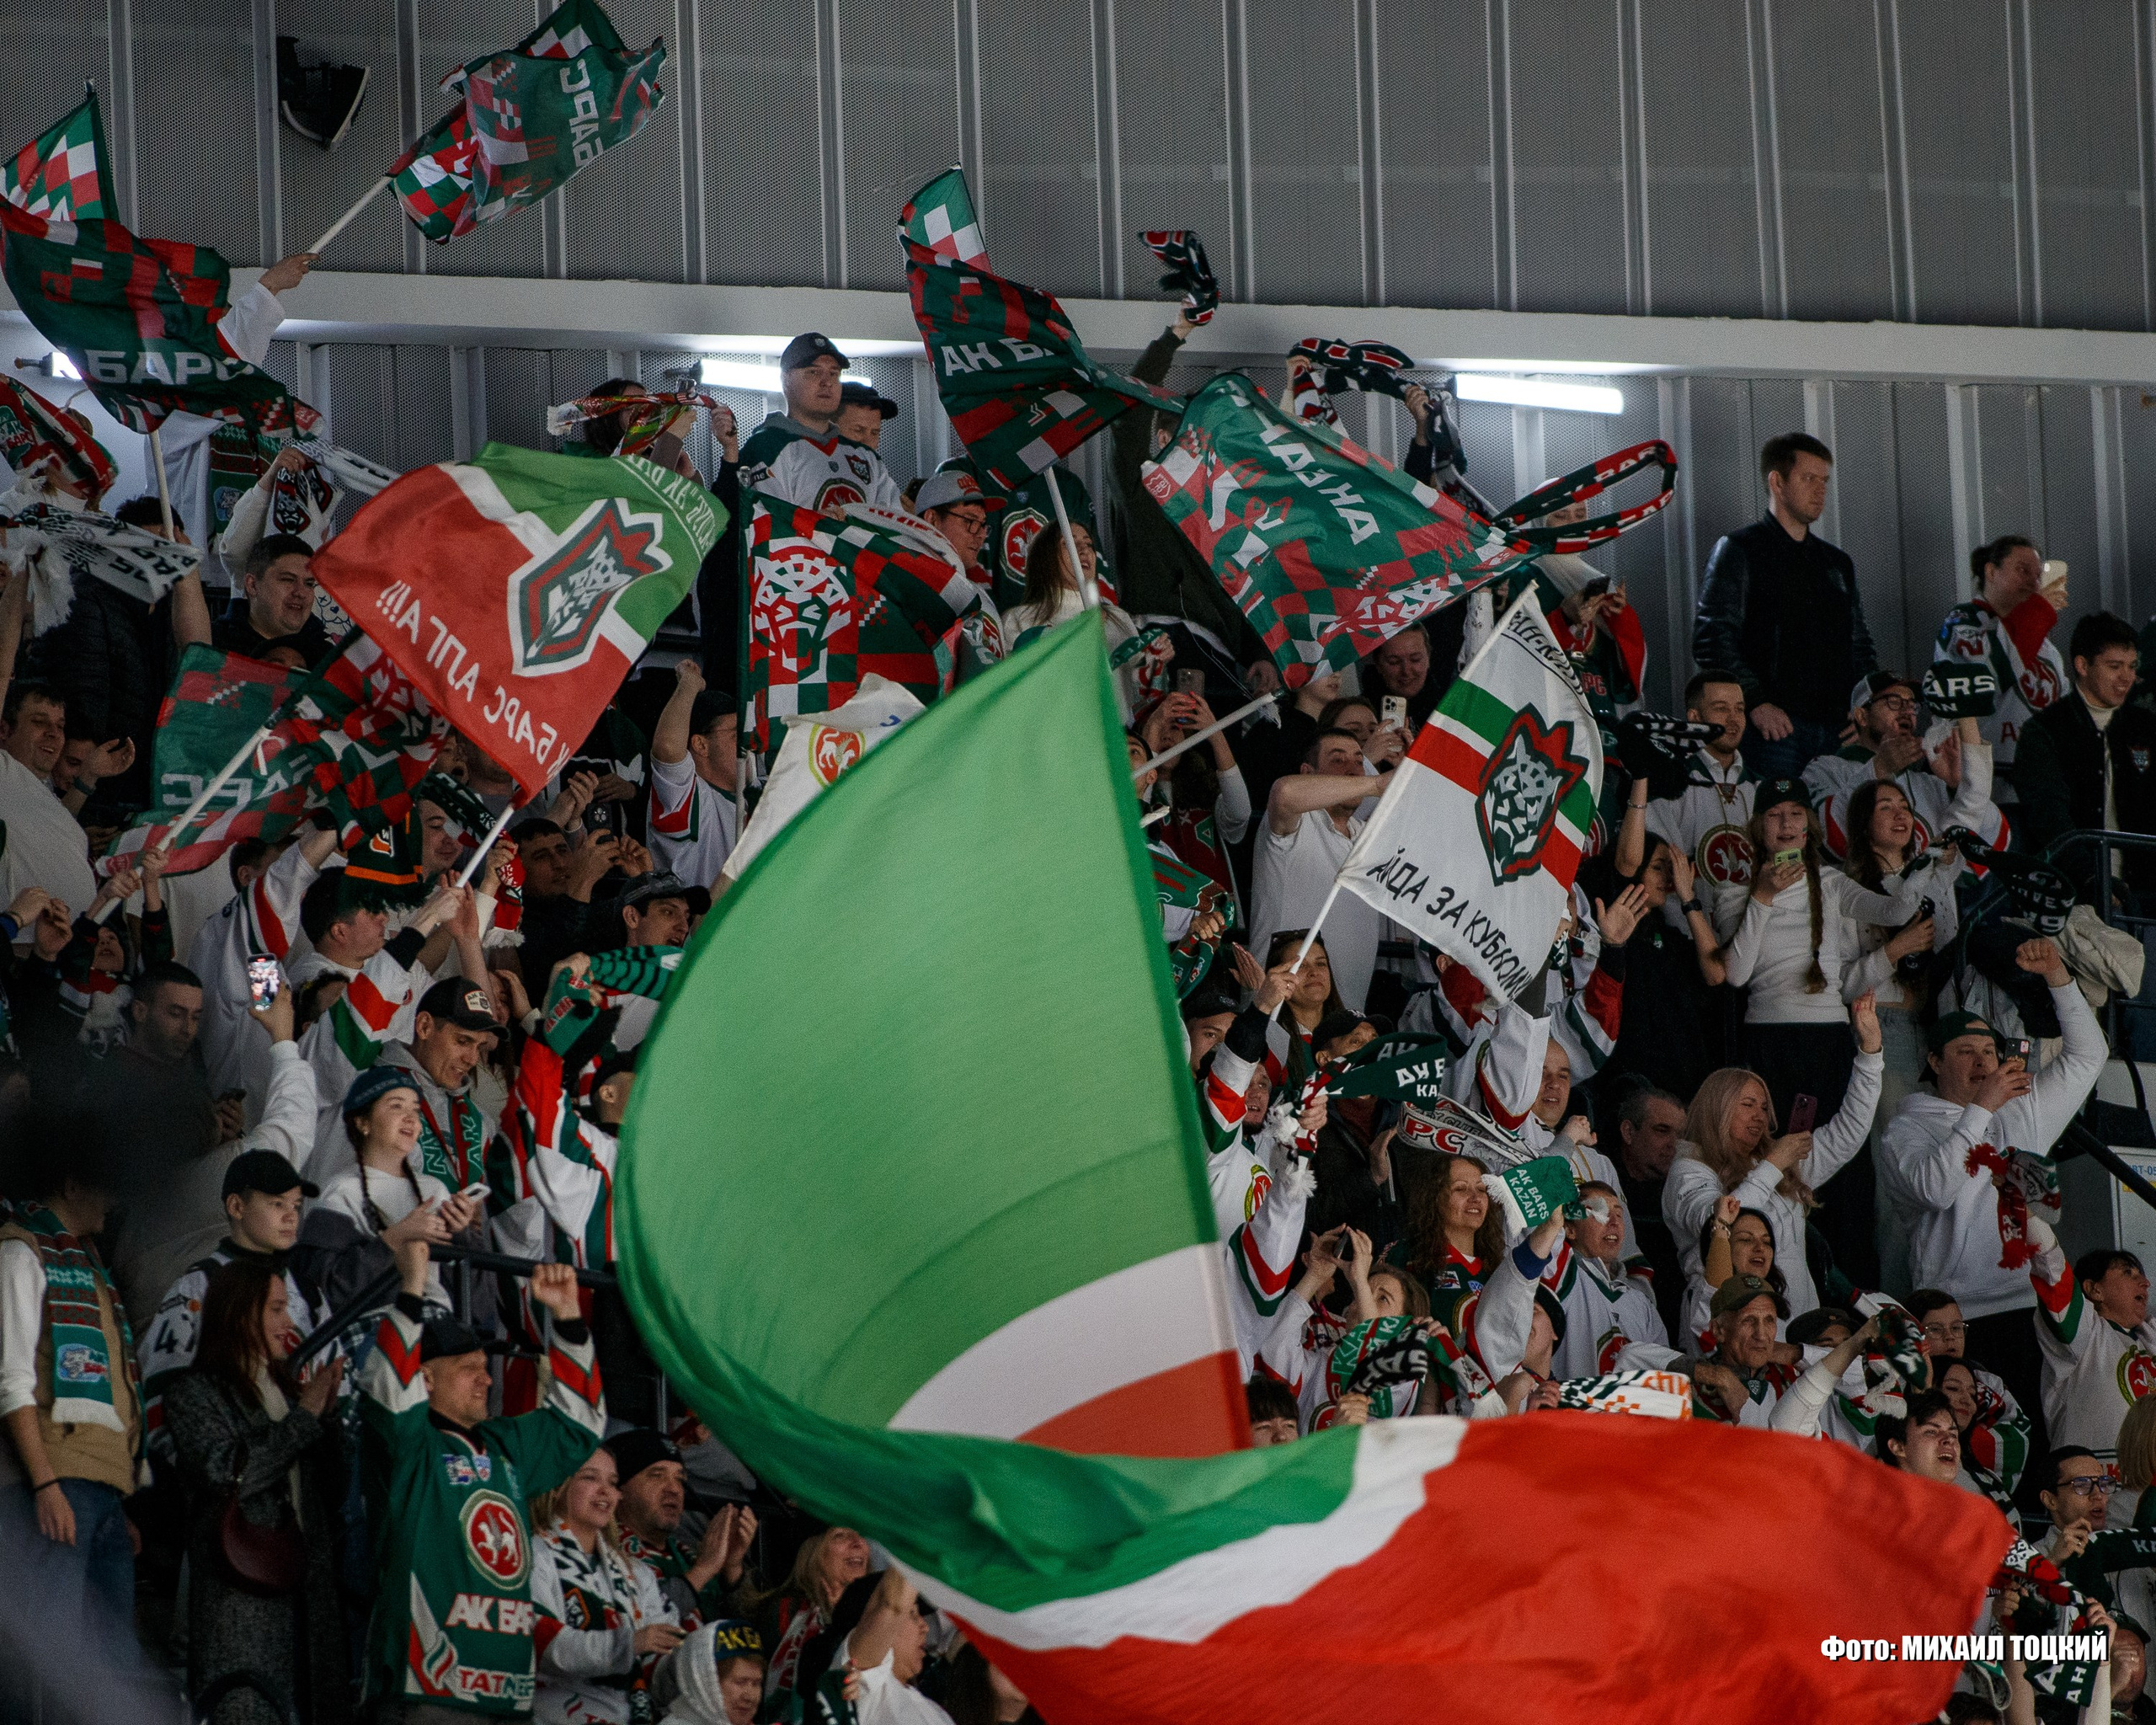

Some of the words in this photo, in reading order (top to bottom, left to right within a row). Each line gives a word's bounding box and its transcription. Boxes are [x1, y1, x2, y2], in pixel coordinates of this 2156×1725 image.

[1426, 886, 1470, 928] ЗА
[1509, 1177, 1538, 1218] KAZAN
[1517, 1169, 1533, 1185] AK
[1528, 1186, 1549, 1220] BARS
[445, 1591, 495, 1632] АК
